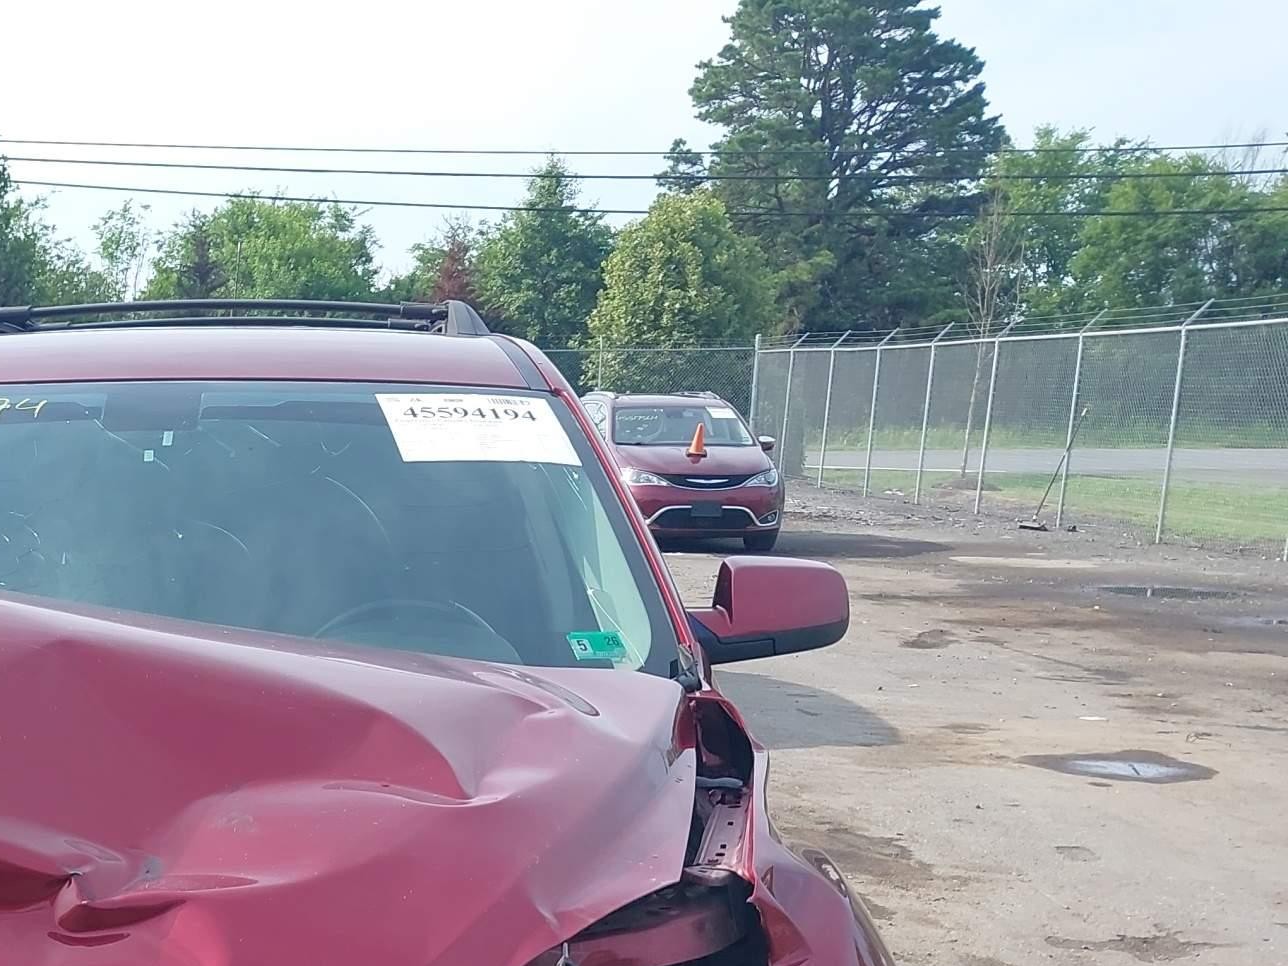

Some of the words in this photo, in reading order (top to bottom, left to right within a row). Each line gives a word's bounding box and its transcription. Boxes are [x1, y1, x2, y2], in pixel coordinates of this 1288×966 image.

[402, 405, 537, 422] 45594194
[576, 639, 588, 652] 5
[604, 635, 620, 647] 26
